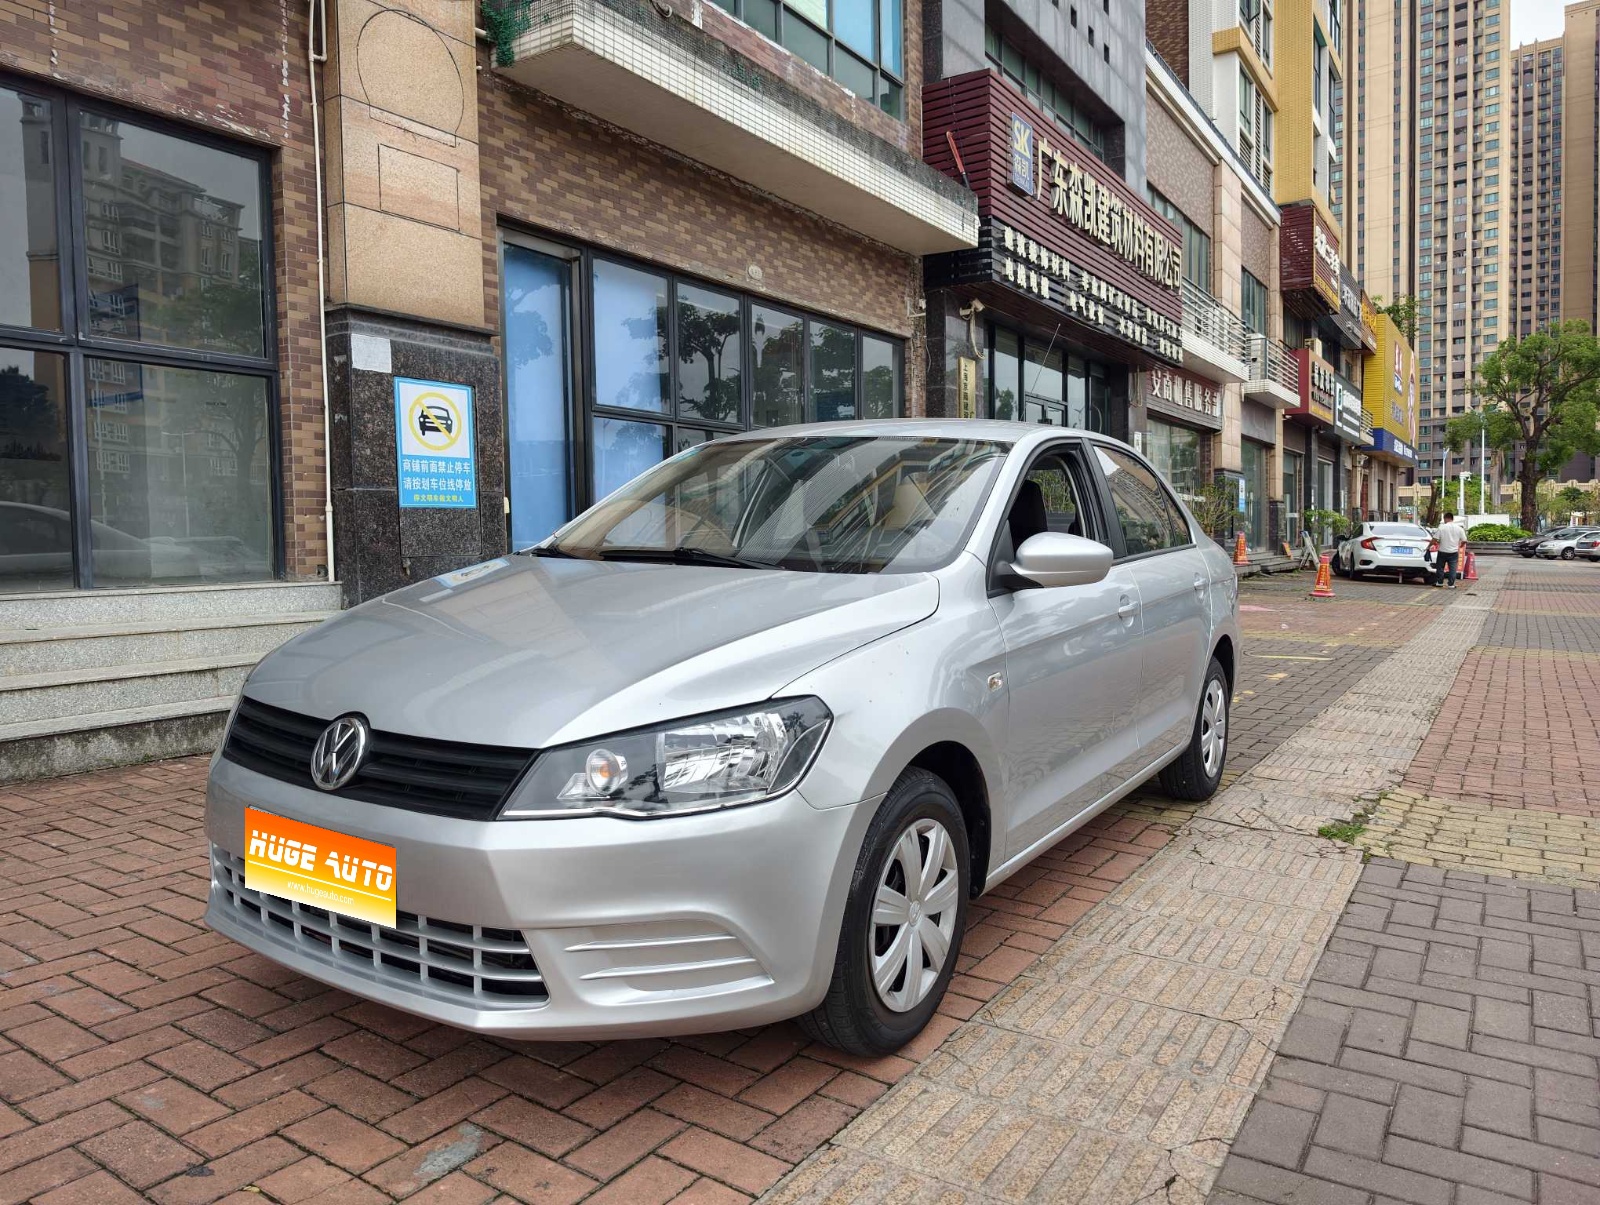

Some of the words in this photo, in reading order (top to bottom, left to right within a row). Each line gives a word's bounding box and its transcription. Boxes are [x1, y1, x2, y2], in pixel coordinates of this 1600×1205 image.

[1014, 120, 1031, 159] SK
[1014, 154, 1030, 180] 森凯
[1037, 136, 1183, 295] 广东森凯建筑材料有限公司
[402, 458, 471, 475] 商铺前面禁止停车
[403, 477, 472, 491] 请按划车位线停放
